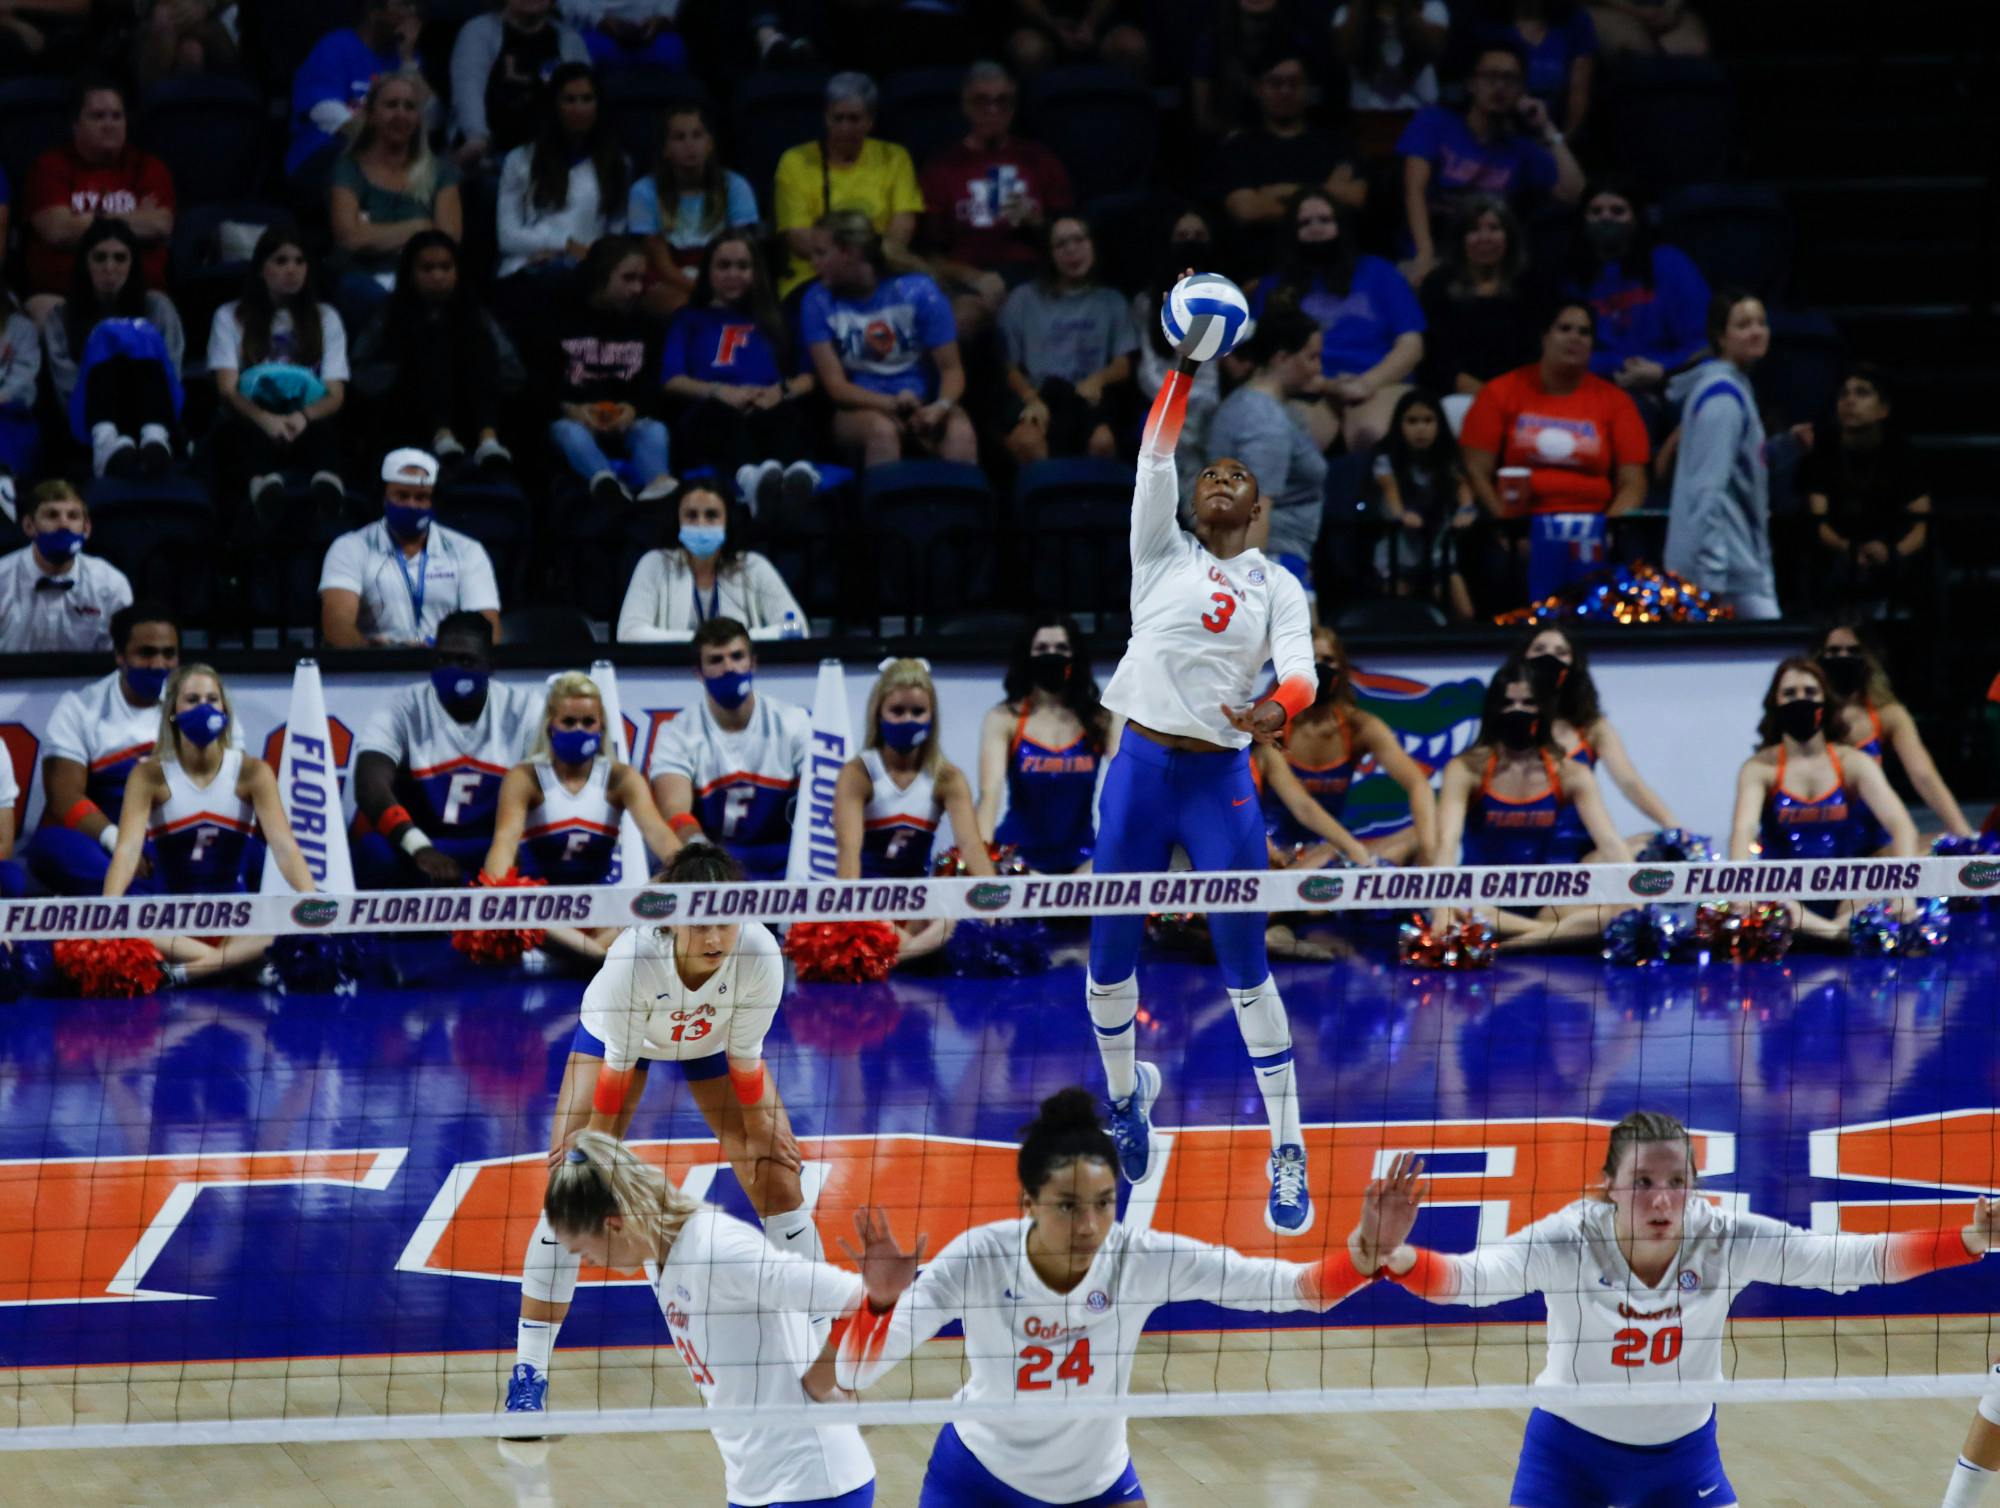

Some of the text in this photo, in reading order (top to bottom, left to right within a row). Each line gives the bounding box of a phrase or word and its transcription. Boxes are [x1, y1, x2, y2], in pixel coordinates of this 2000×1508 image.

[711, 323, 754, 368] F
[1201, 591, 1236, 634] 3
[293, 734, 327, 892] FLORID
[443, 774, 484, 825] F
[720, 785, 757, 838] F
[808, 730, 845, 882] FLORID
[192, 832, 221, 863] F
[562, 832, 592, 862] F
[885, 828, 917, 861] F
[1023, 880, 1141, 908] FLORIDA
[1150, 877, 1259, 904] GATORS
[1354, 871, 1590, 900] FLORIDA GATORS
[1685, 867, 1803, 894] FLORIDA
[1811, 864, 1921, 891] GATORS
[6, 902, 252, 932] FLORIDA GATORS
[350, 894, 592, 924] FLORIDA GATORS
[688, 886, 927, 916] FLORIDA GATORS
[671, 1018, 713, 1042] 13
[1612, 1326, 1682, 1367] 20
[1017, 1338, 1094, 1391] 24
